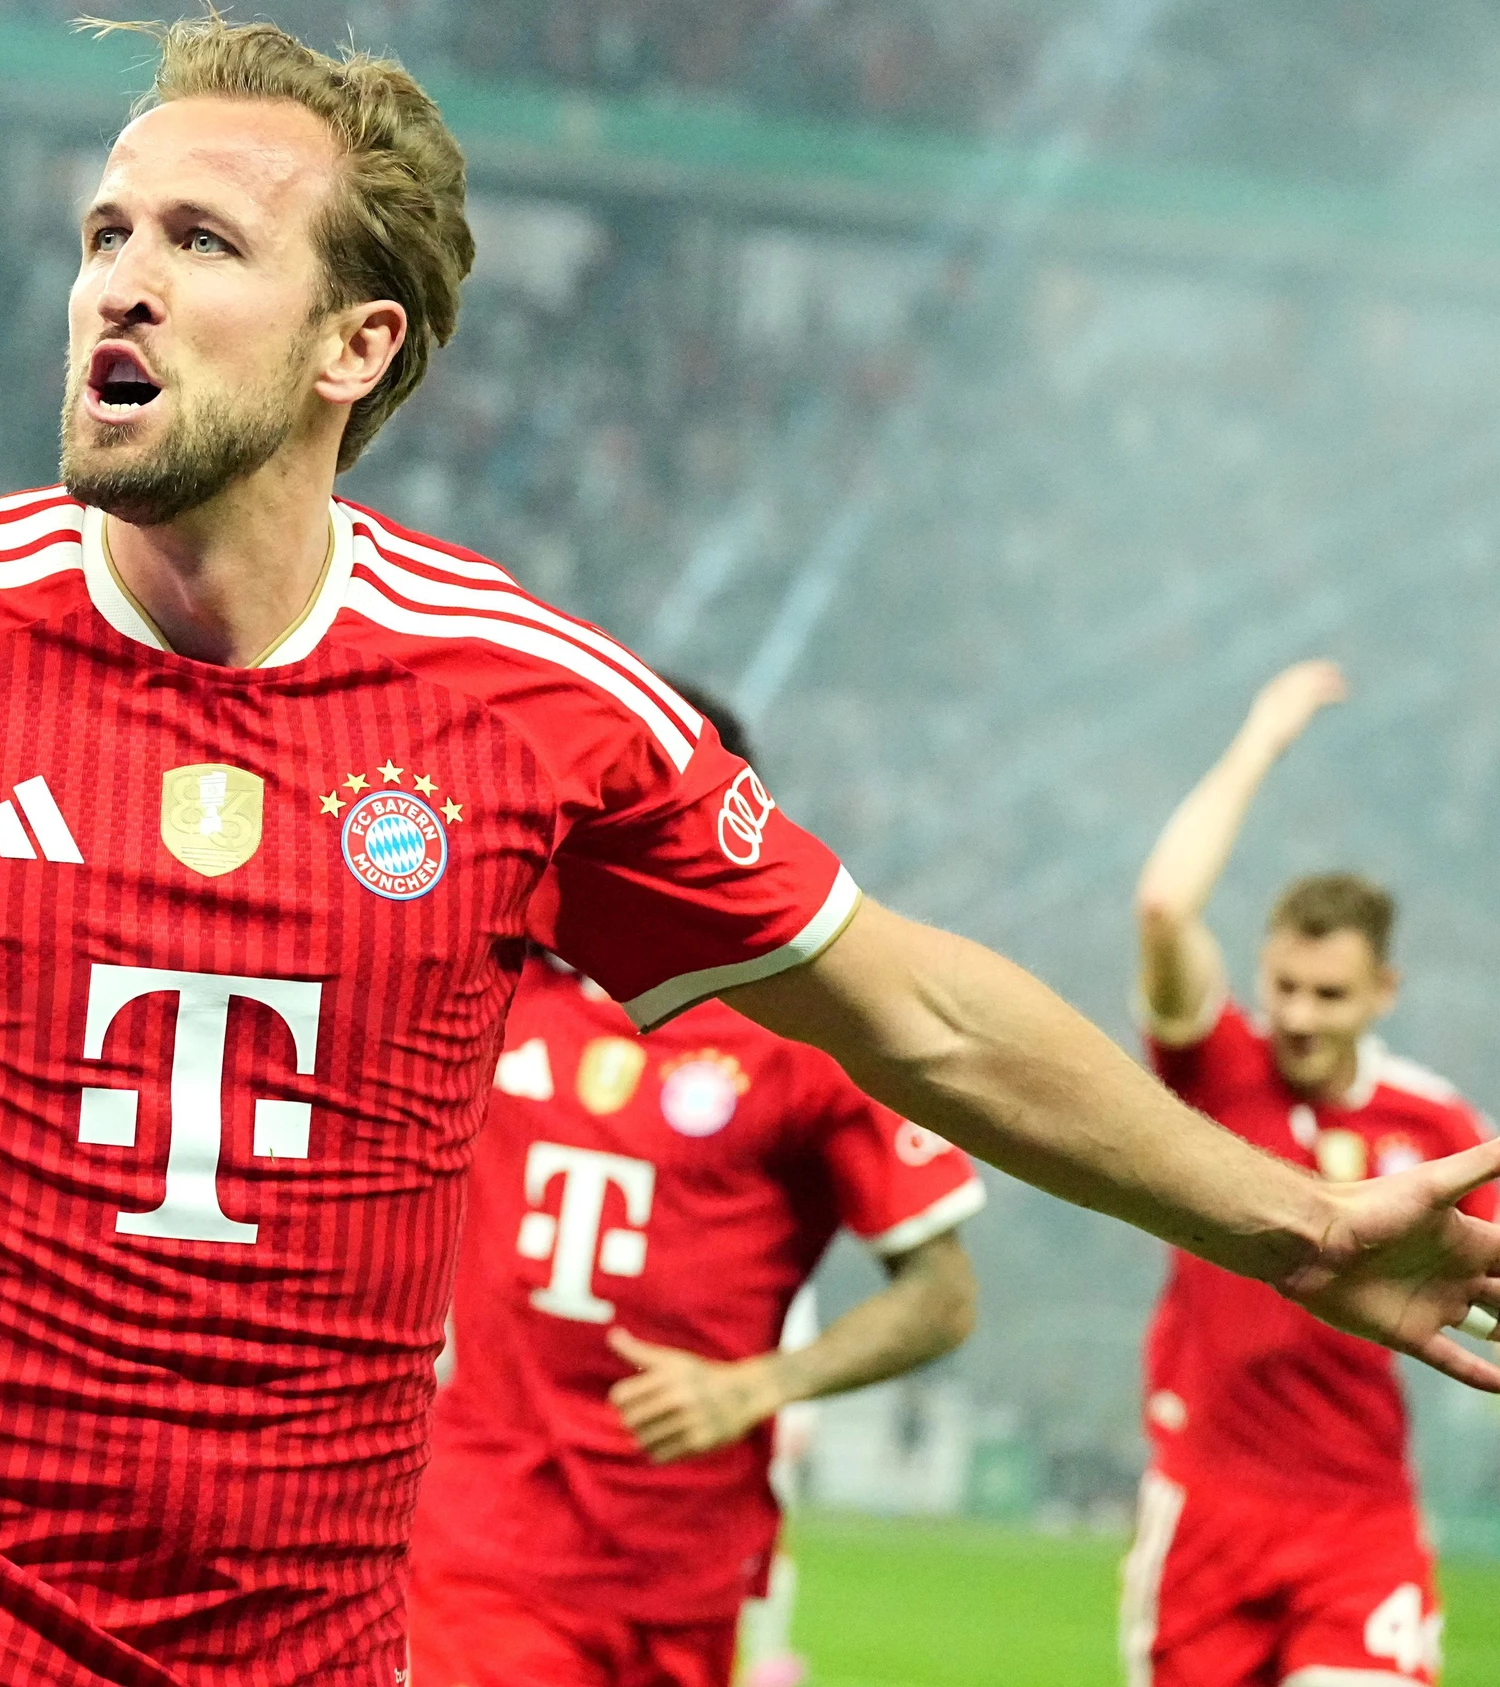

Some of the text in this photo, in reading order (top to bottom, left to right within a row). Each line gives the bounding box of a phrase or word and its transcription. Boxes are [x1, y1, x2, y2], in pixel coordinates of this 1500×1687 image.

[351, 799, 437, 840] FC BAYERN
[353, 853, 438, 892] MÜNCHEN
[78, 963, 323, 1245] T
[517, 1140, 656, 1325] T
